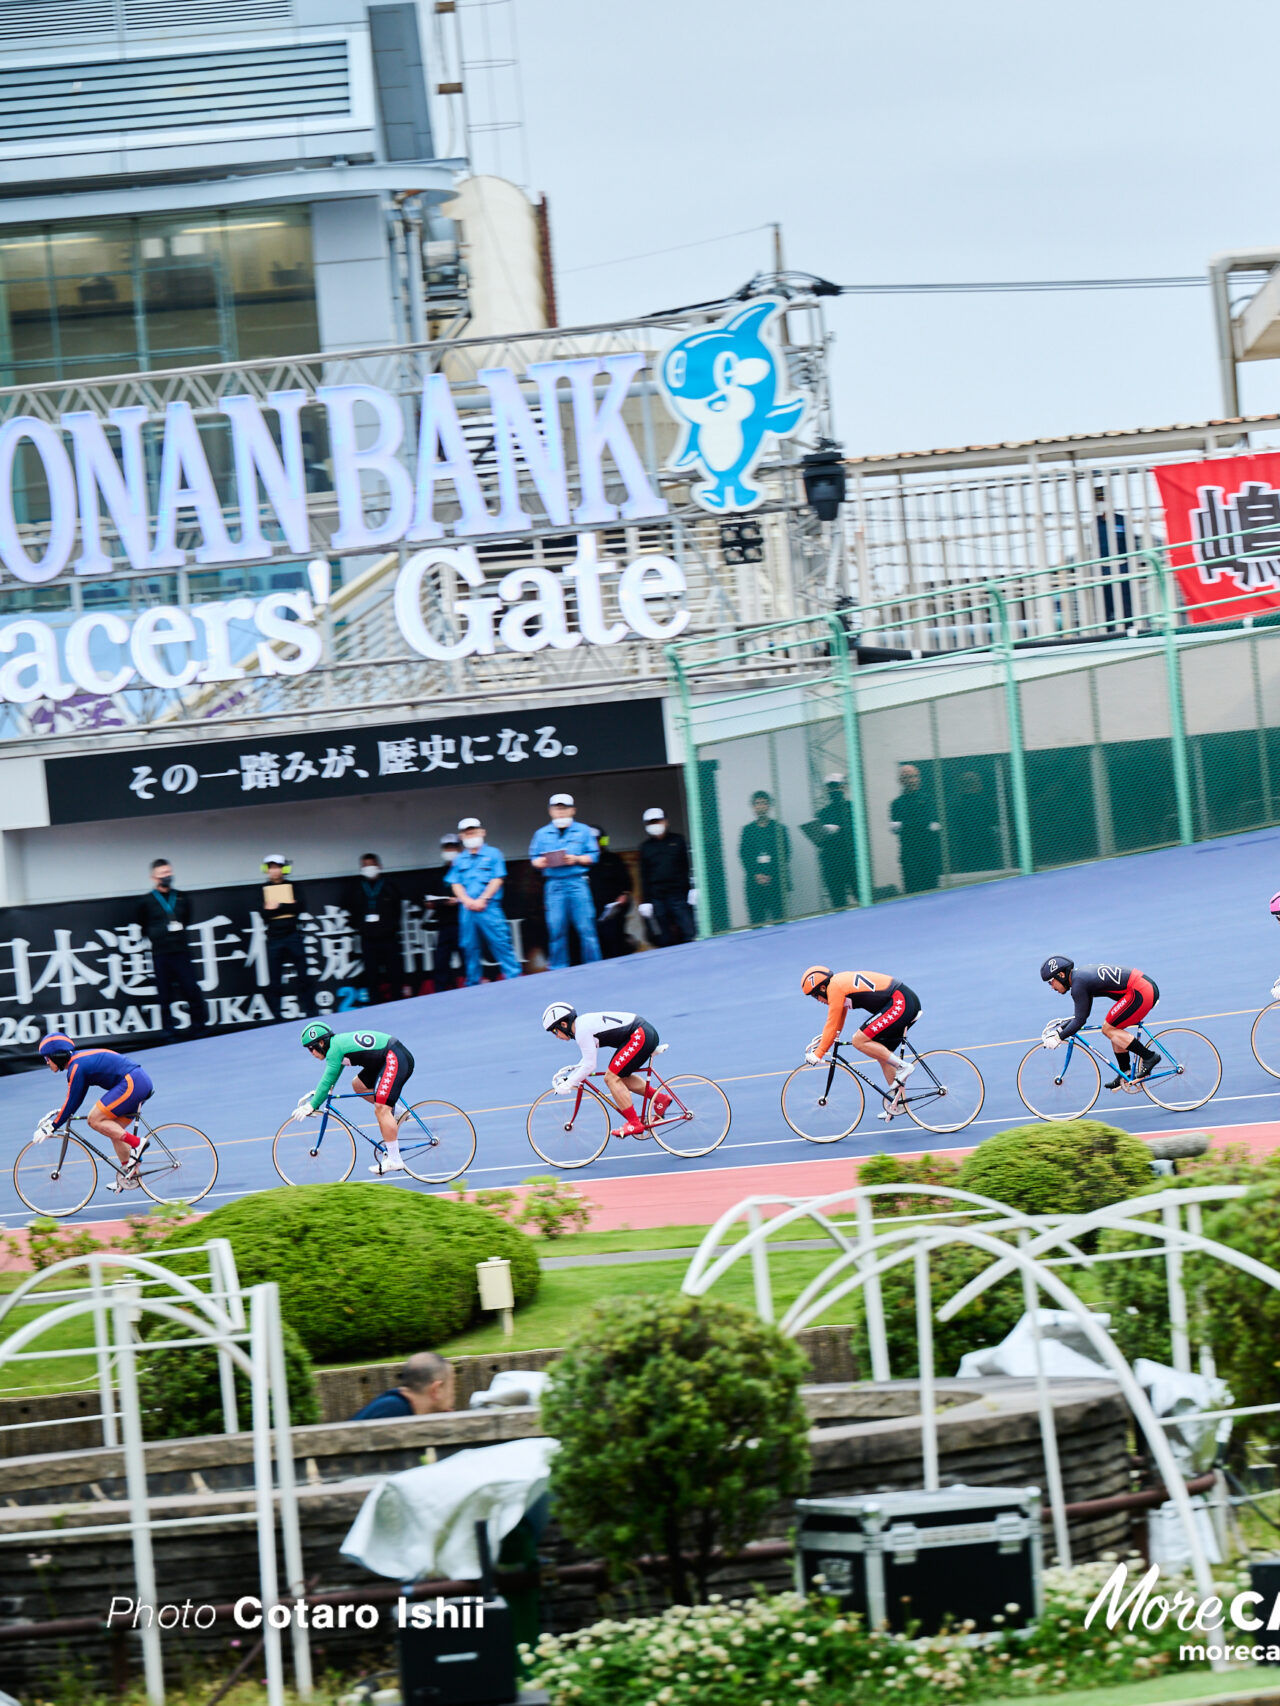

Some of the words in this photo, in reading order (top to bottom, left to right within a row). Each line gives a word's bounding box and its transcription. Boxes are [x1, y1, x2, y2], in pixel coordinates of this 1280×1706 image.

[0, 389, 311, 584] ONAN
[316, 352, 671, 550] BANK
[394, 532, 692, 662] Gate
[128, 726, 579, 799] その一踏みが、歴史になる。
[1048, 958, 1058, 972] 2
[1097, 965, 1122, 985] 2
[852, 973, 876, 992] 7
[353, 1032, 377, 1050] 6
